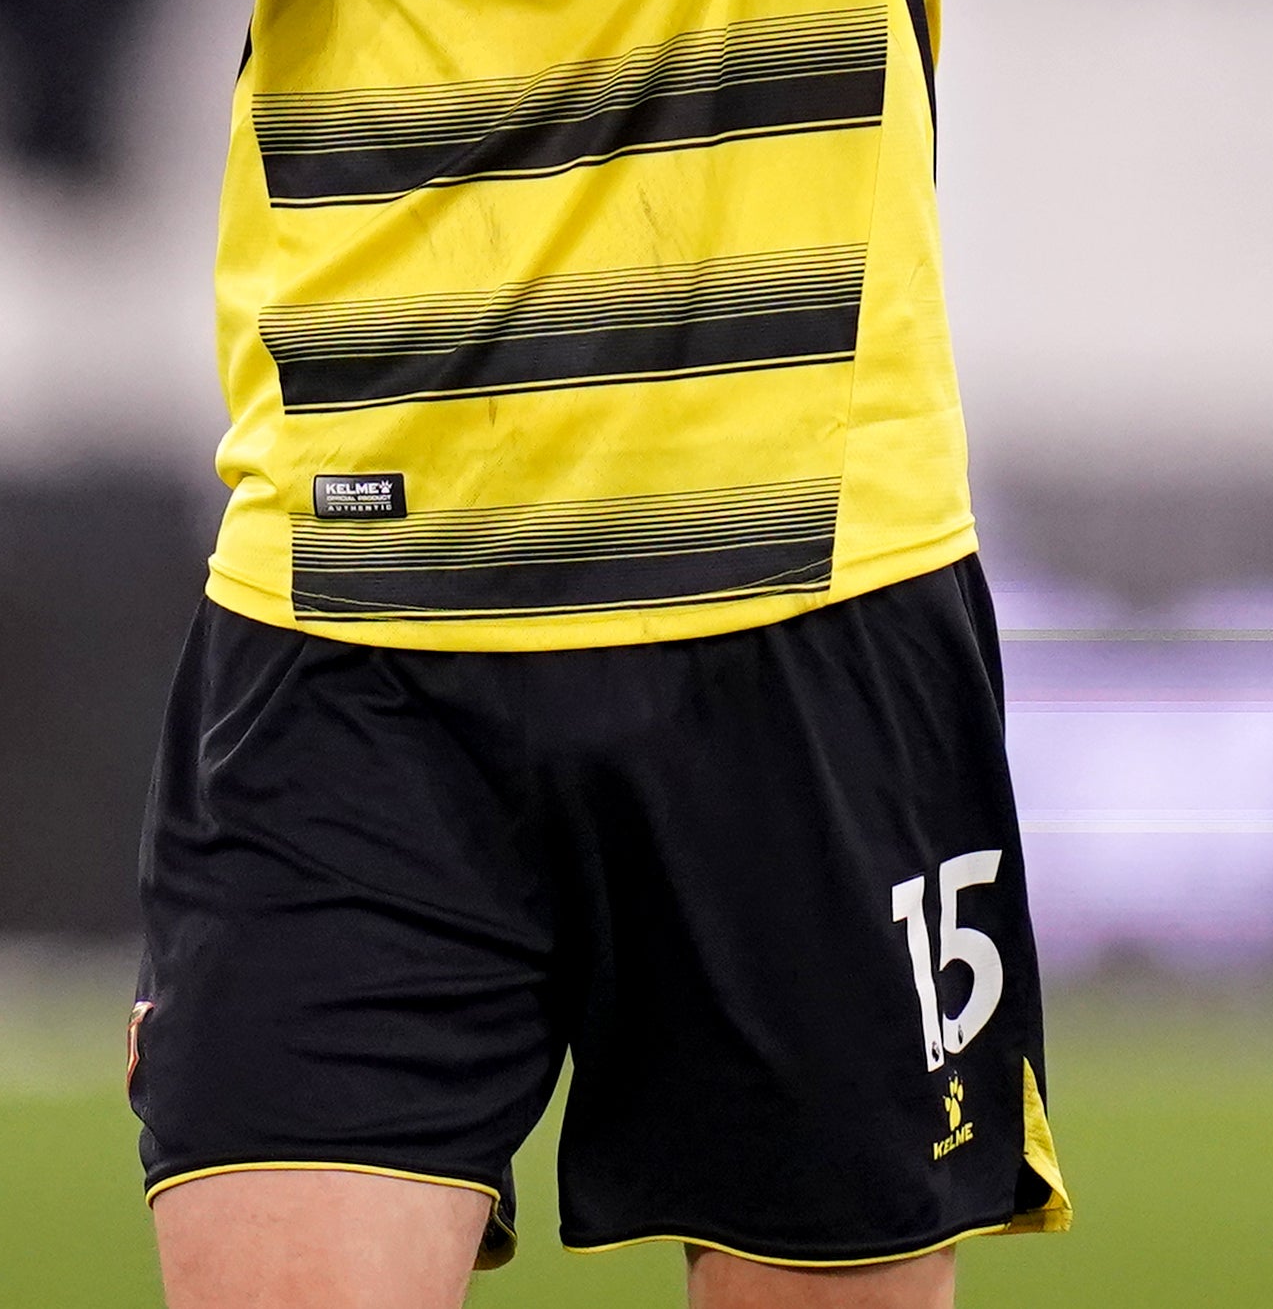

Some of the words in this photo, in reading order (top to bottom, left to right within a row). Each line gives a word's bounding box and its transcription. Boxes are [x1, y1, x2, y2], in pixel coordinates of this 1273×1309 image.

[325, 482, 379, 495] KELME
[328, 504, 393, 512] AUTHENTIC
[892, 849, 1003, 1073] 15
[933, 1122, 974, 1161] KELME
